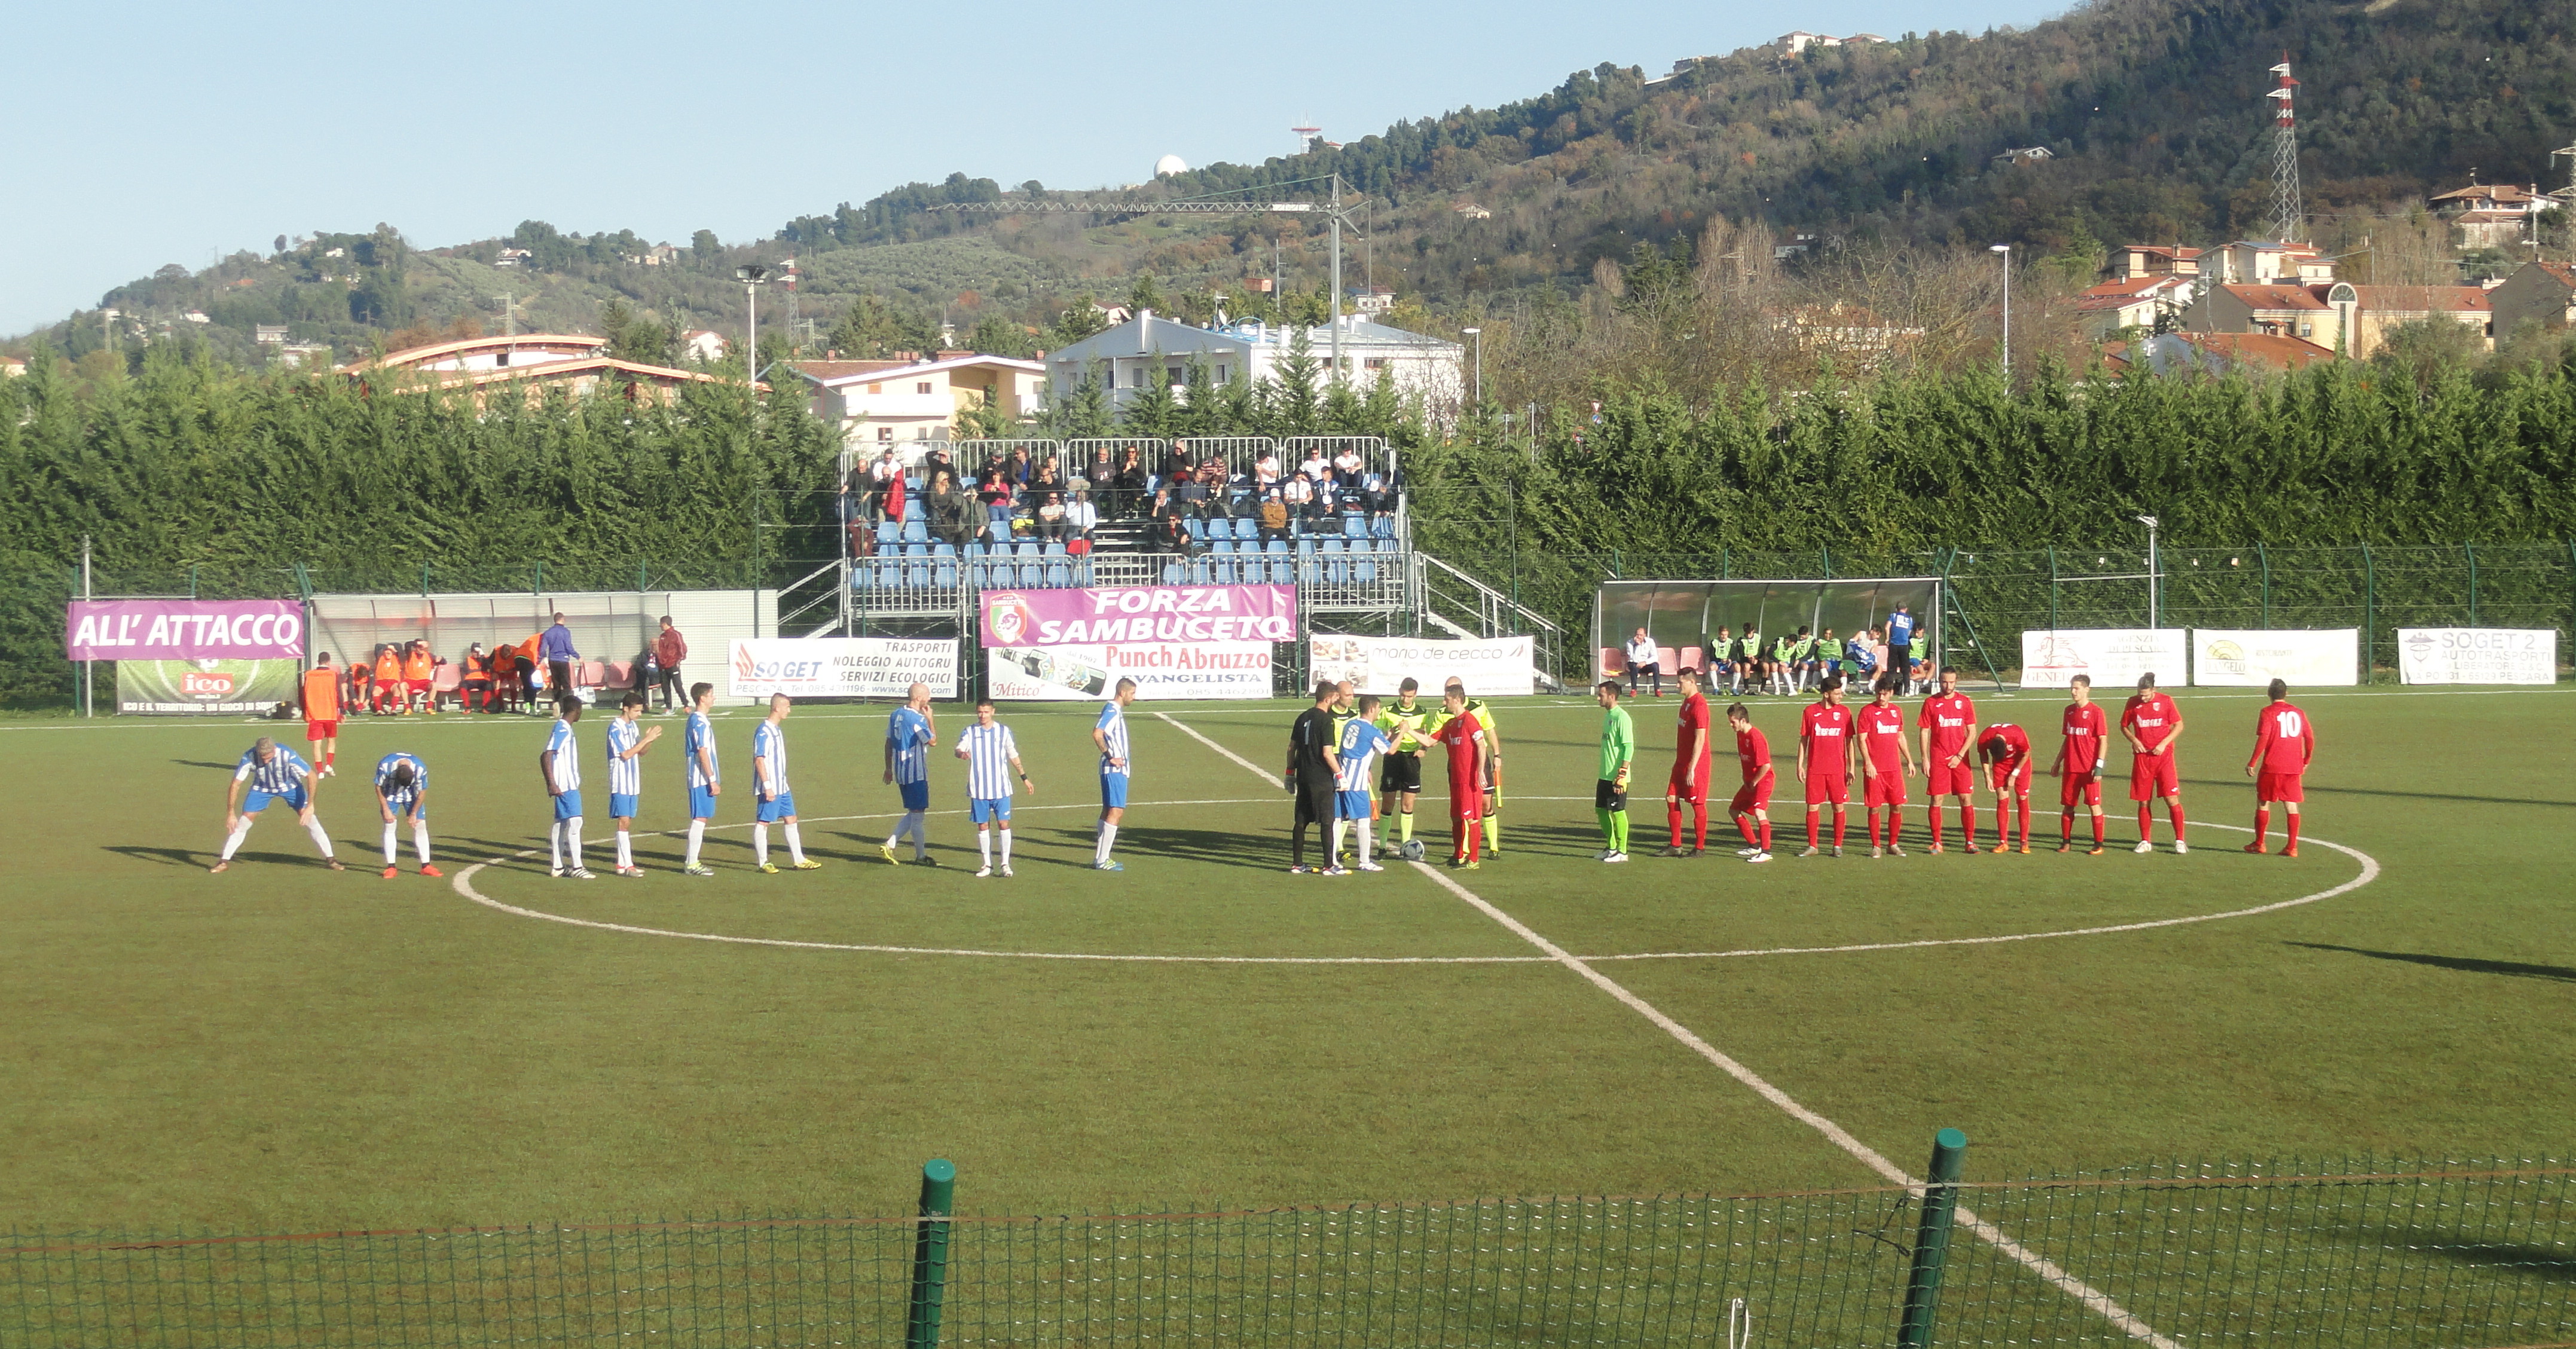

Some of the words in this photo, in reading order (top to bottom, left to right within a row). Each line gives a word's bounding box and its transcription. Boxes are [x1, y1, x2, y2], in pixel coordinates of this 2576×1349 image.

[1095, 589, 1232, 614] FORZA
[73, 614, 142, 647] ALL'
[145, 614, 300, 646] ATTACCO
[1037, 616, 1290, 644] SAMBUCETO
[2441, 632, 2517, 649] SOGET
[2524, 634, 2535, 649] 2
[885, 642, 951, 653] TRASPORTI
[1372, 647, 1418, 659] mario
[1423, 647, 1444, 659] de
[1448, 648, 1502, 660] cecco
[833, 656, 891, 668] NOLEGGIO
[896, 657, 951, 668] AUTOGRU
[1079, 654, 1098, 663] 1907
[1106, 646, 1172, 668] Punch
[1177, 647, 1270, 670] Abruzzo
[2441, 650, 2551, 662] AUTOTRASPORTI
[754, 661, 823, 678] SOGET
[2454, 662, 2516, 670] LIBERATORE
[840, 671, 885, 682] SERVIZI
[889, 672, 951, 683] ECOLOGICI
[2027, 672, 2088, 681] GENER
[2445, 671, 2459, 680] 131
[2469, 672, 2496, 680] 65129
[2499, 672, 2550, 681] PESCARA
[185, 674, 231, 692] ico
[123, 702, 137, 711] ICO
[139, 702, 145, 711] E
[2276, 711, 2301, 738] 10
[1303, 720, 1311, 745] 1
